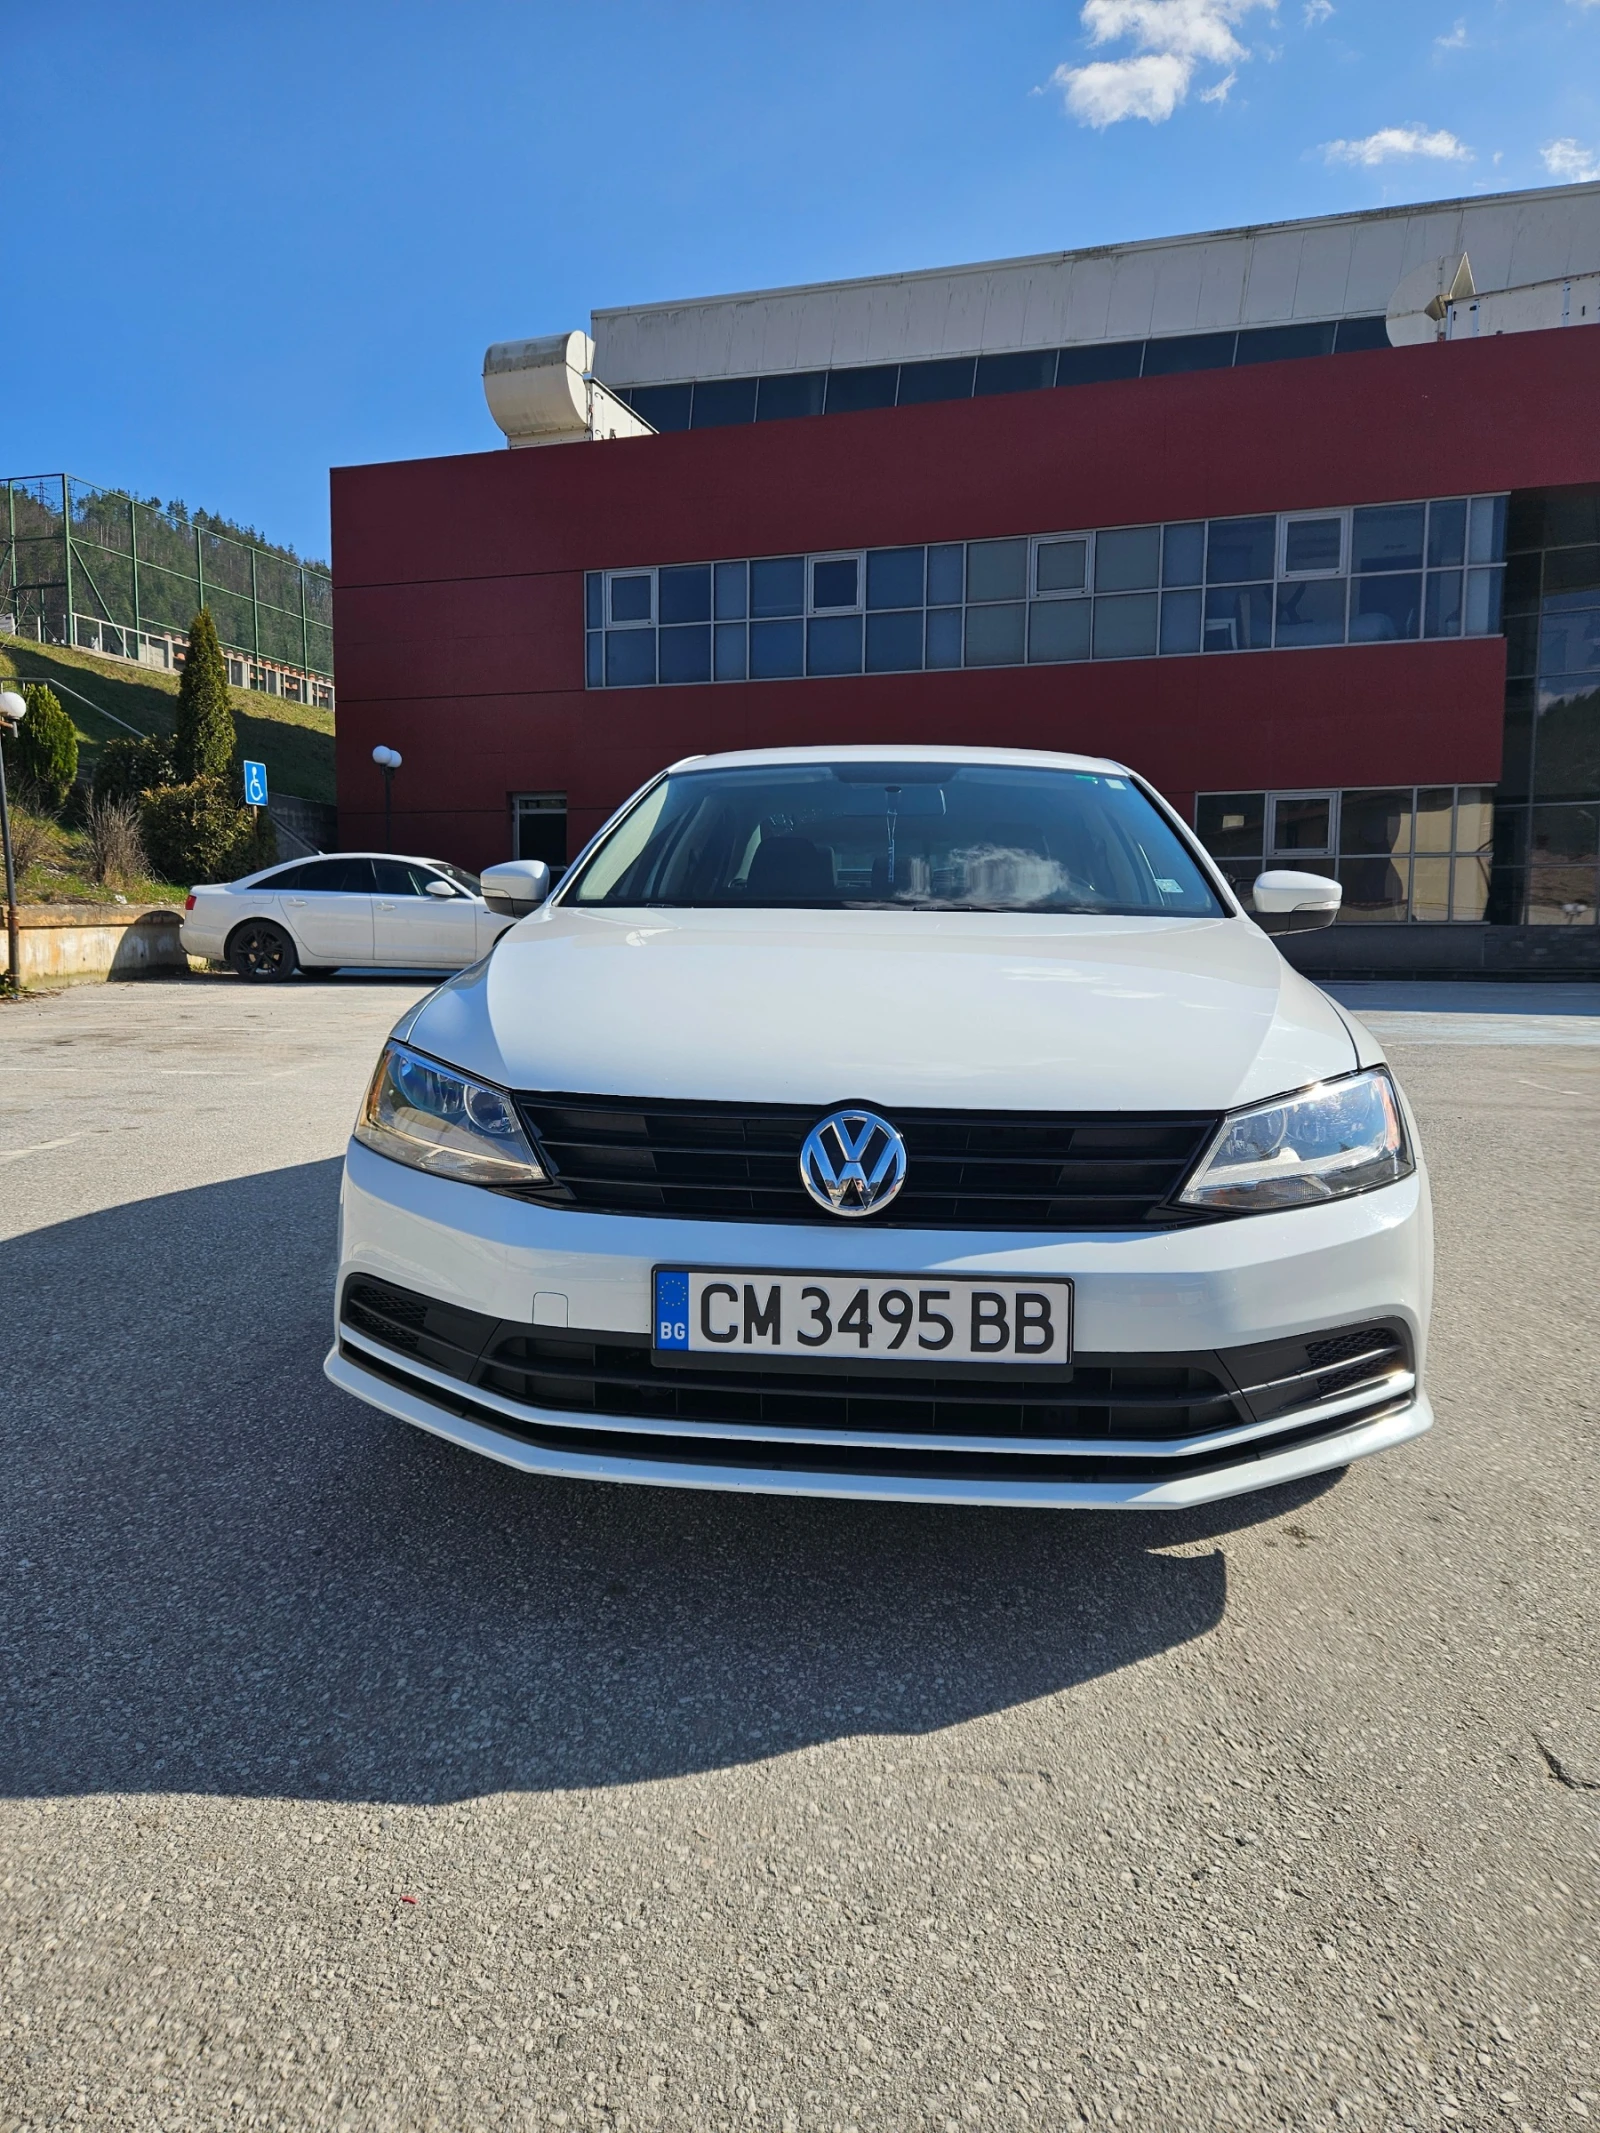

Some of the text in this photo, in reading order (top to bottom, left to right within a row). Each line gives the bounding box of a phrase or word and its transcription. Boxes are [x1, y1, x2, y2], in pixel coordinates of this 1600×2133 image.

[802, 1110, 906, 1216] VW
[661, 1322, 686, 1340] BG
[701, 1283, 1054, 1354] CM 3495 BB
